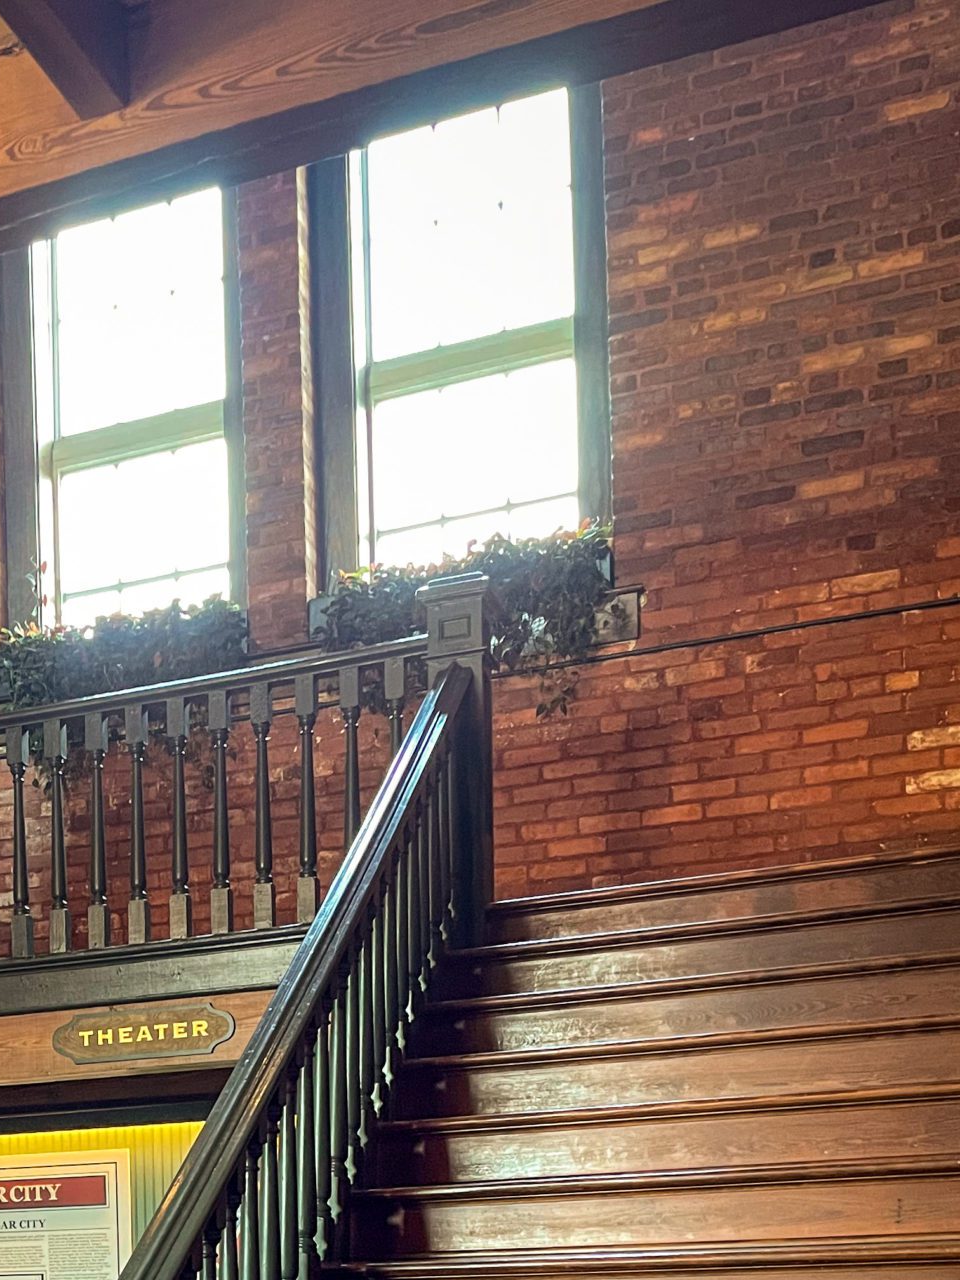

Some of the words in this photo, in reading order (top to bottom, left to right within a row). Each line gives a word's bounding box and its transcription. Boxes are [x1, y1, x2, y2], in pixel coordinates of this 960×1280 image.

[78, 1020, 209, 1047] THEATER
[9, 1183, 62, 1203] CITY
[19, 1219, 46, 1229] CITY
